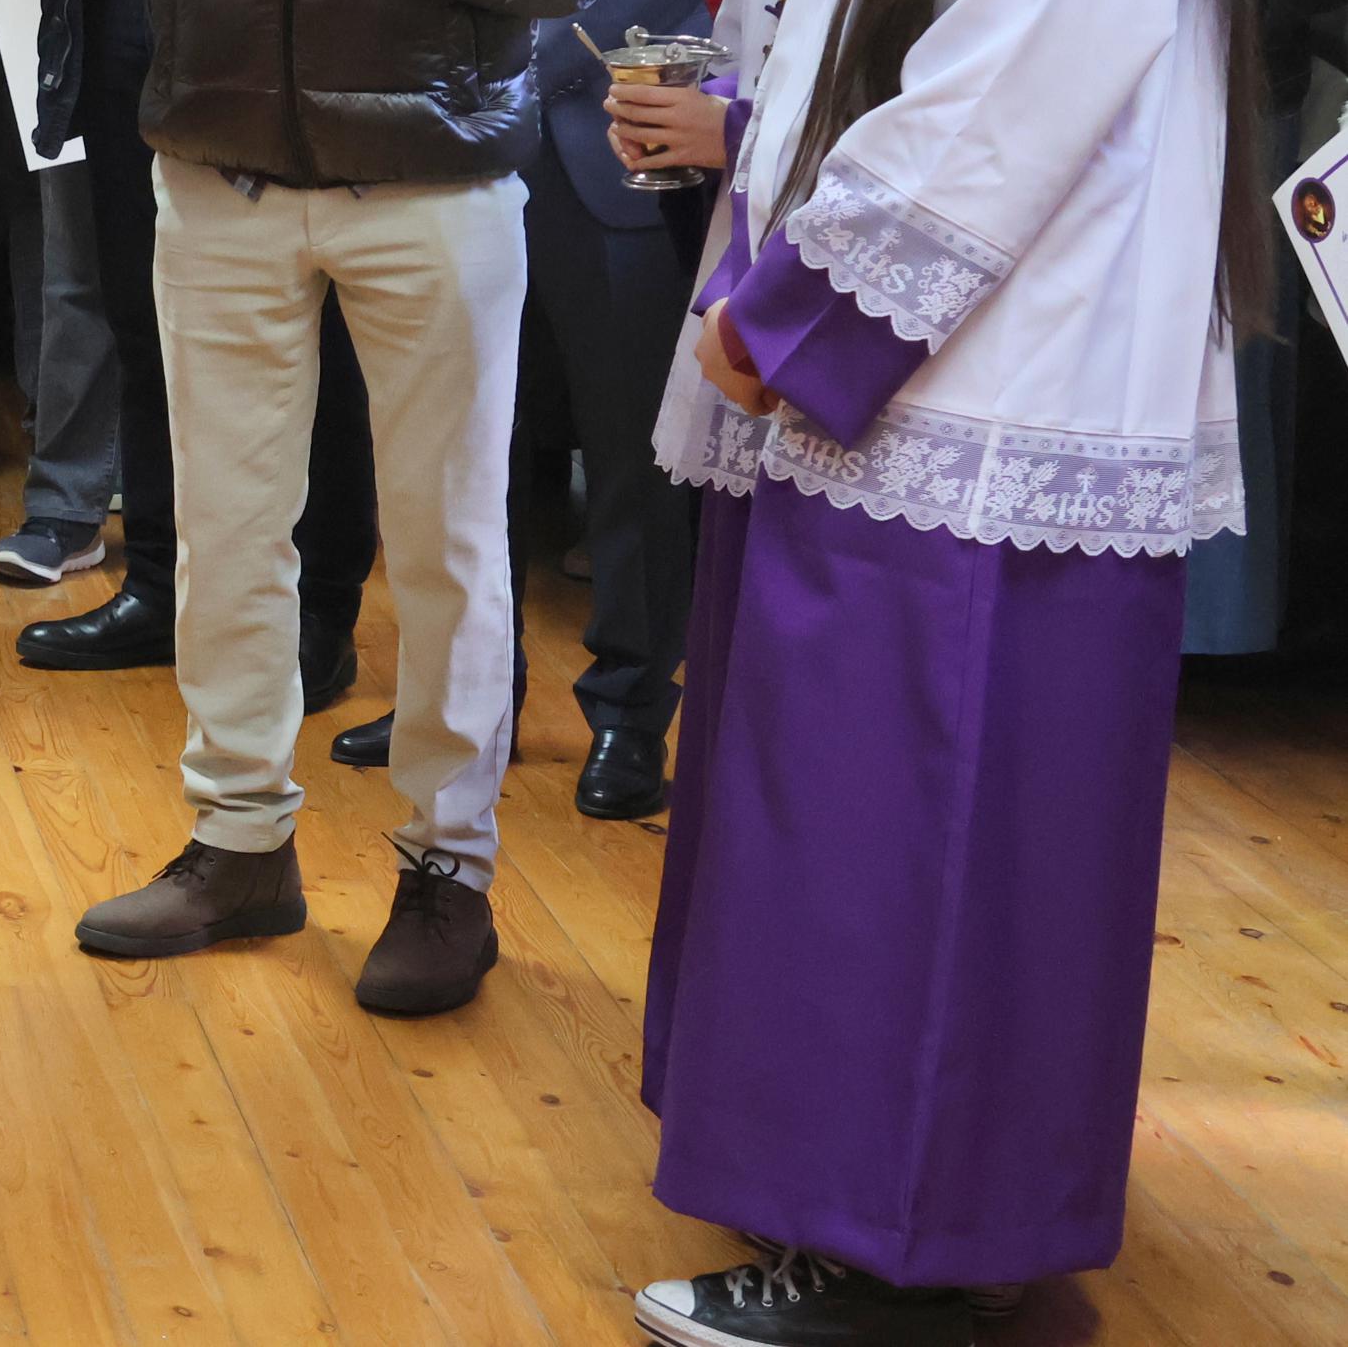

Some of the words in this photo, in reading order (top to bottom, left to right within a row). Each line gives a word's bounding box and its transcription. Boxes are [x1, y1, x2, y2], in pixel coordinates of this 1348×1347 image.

[843, 236, 914, 294] IHS
[801, 435, 867, 484] IHS
[1055, 491, 1116, 528] IHS
